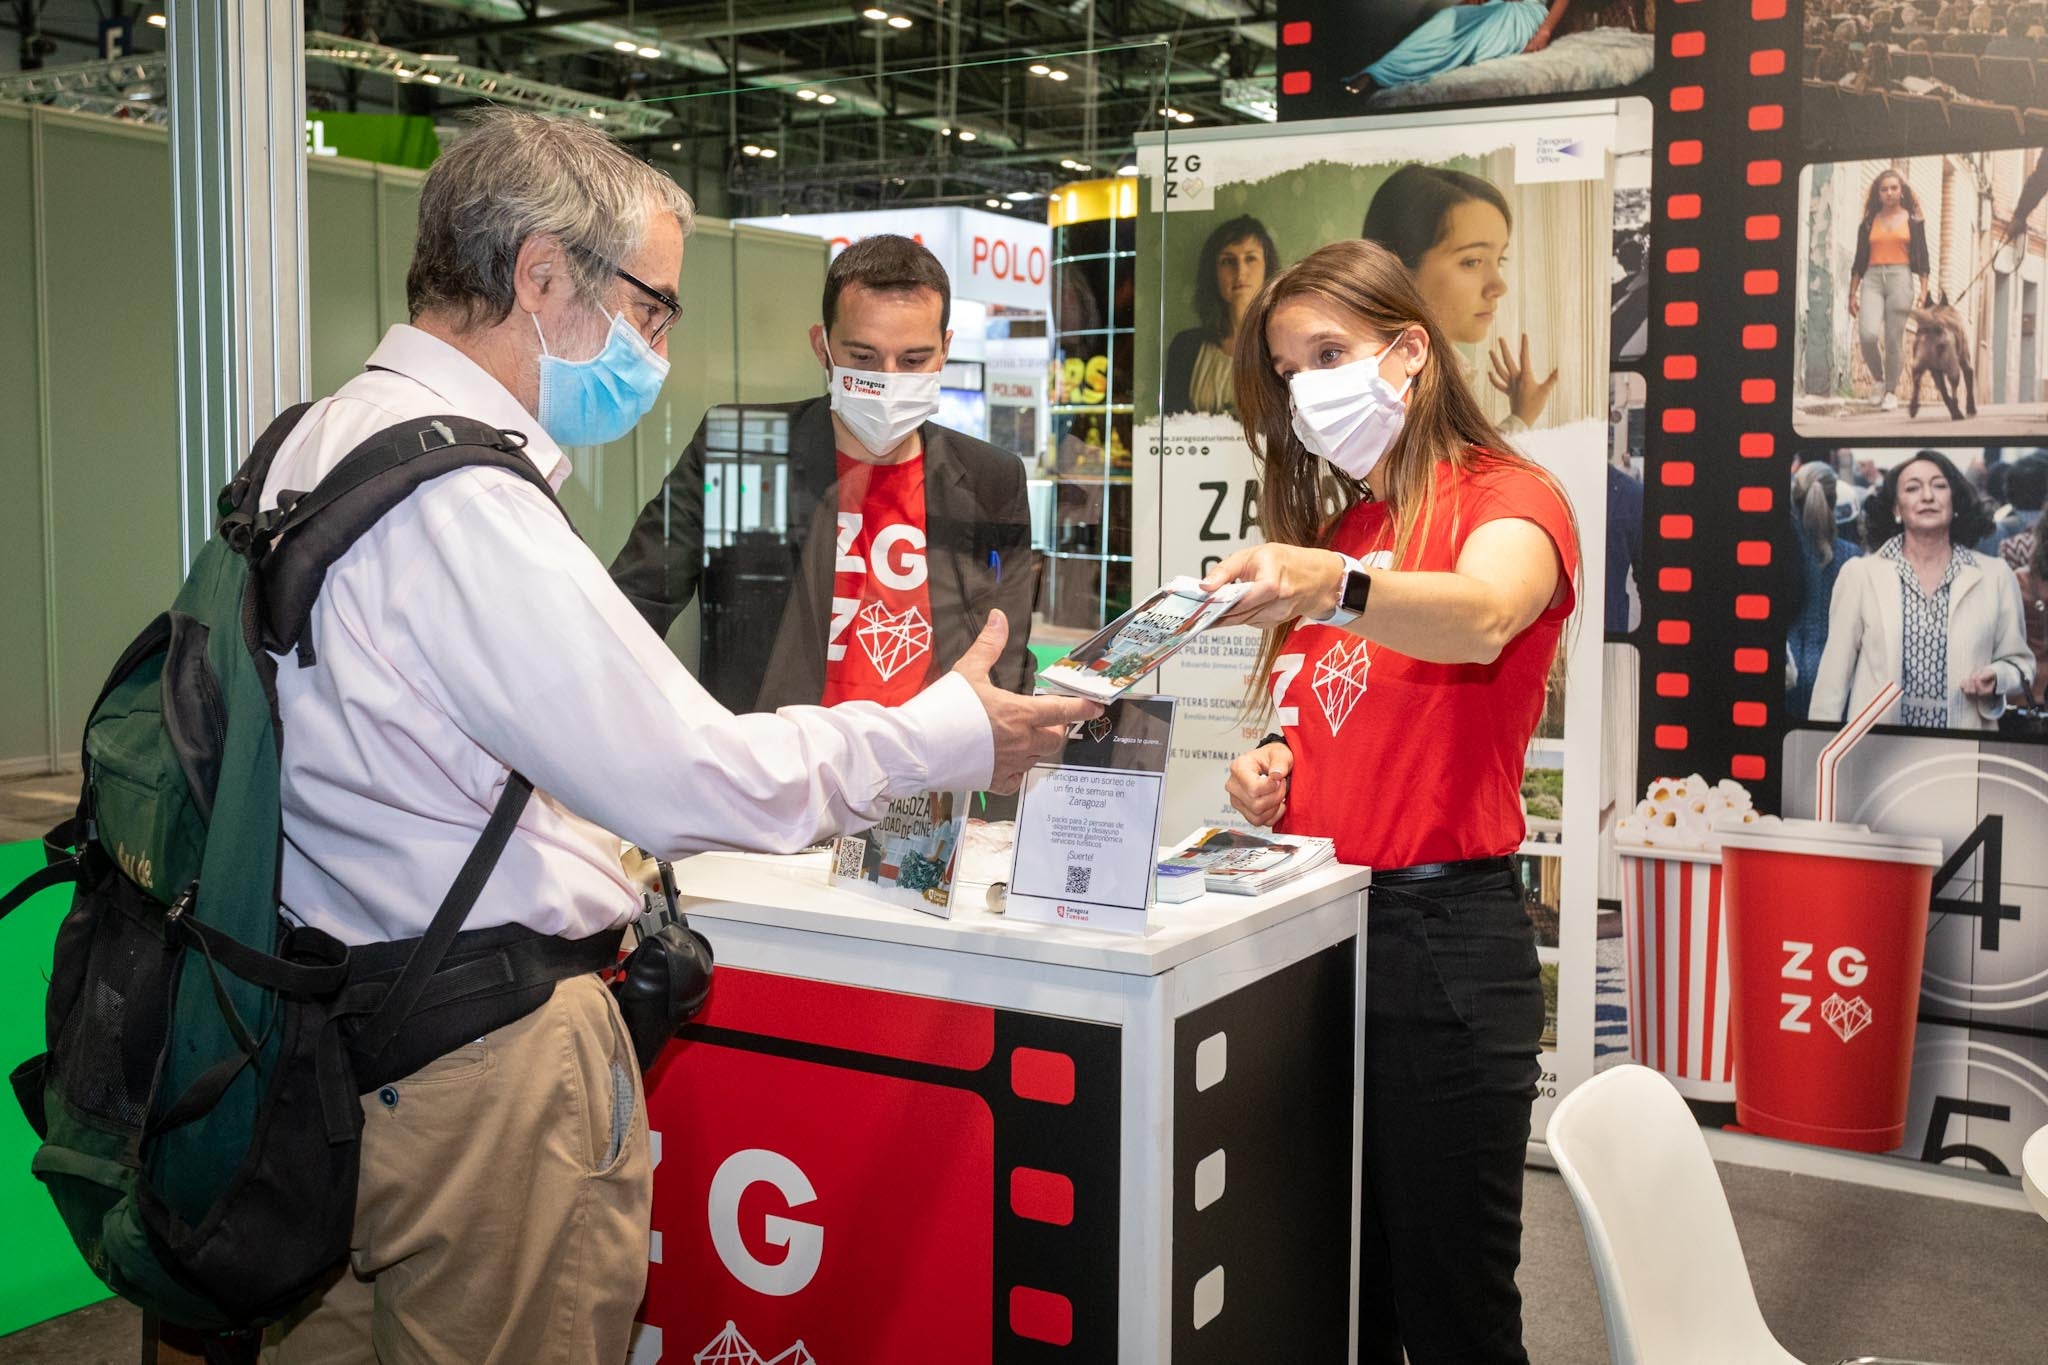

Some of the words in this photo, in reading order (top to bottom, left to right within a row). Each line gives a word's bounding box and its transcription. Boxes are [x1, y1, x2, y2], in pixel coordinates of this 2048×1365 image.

[1185, 155, 1202, 172] G
[972, 235, 1046, 285] POLO
[855, 377, 885, 389] Zaragoza
[870, 523, 929, 591] G
[1929, 814, 2021, 952] 4
[1781, 940, 1814, 982] Z
[1827, 946, 1869, 987] G
[1779, 992, 1812, 1034] Z
[707, 1147, 825, 1297] G
